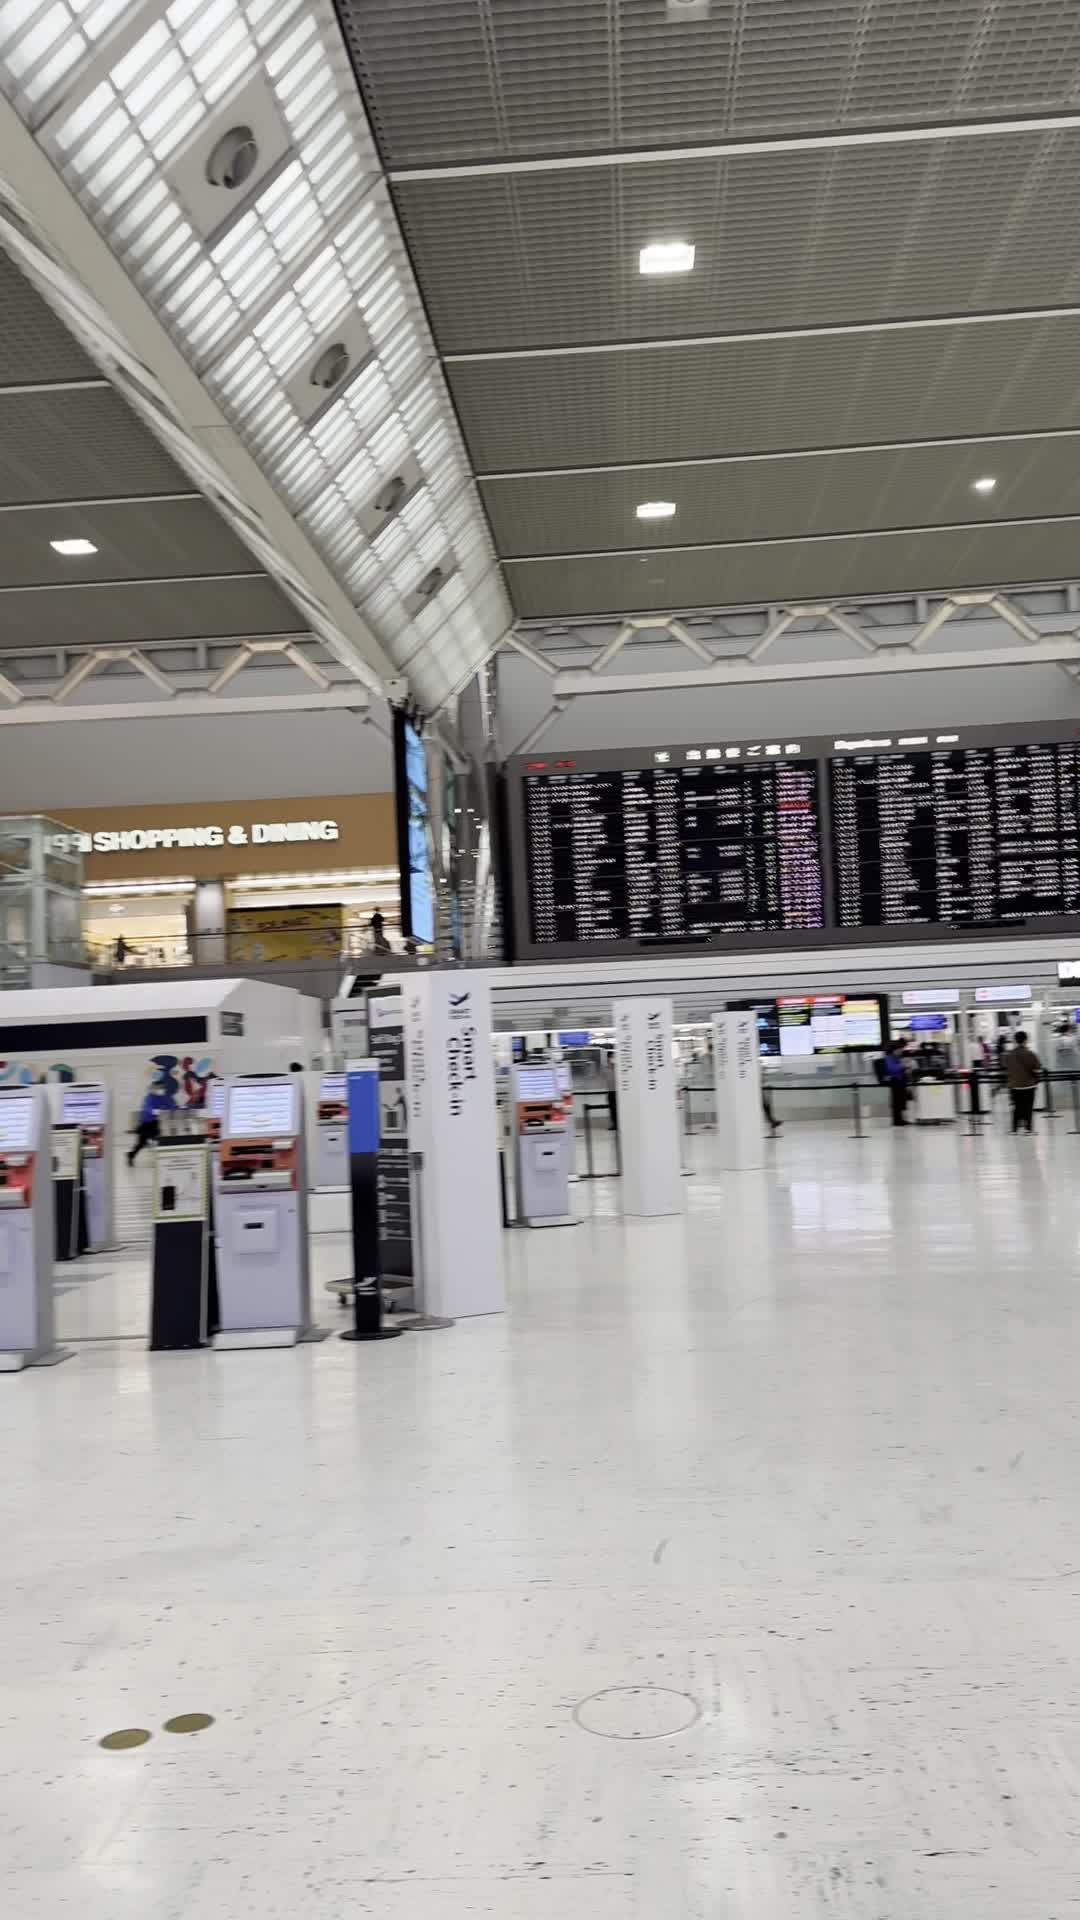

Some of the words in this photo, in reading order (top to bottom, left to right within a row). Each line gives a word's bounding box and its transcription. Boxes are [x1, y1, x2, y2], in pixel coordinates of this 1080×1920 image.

[94, 826, 224, 851] SHOPPING
[228, 825, 249, 845] &
[251, 820, 339, 844] DINING
[459, 1026, 478, 1080] Smart
